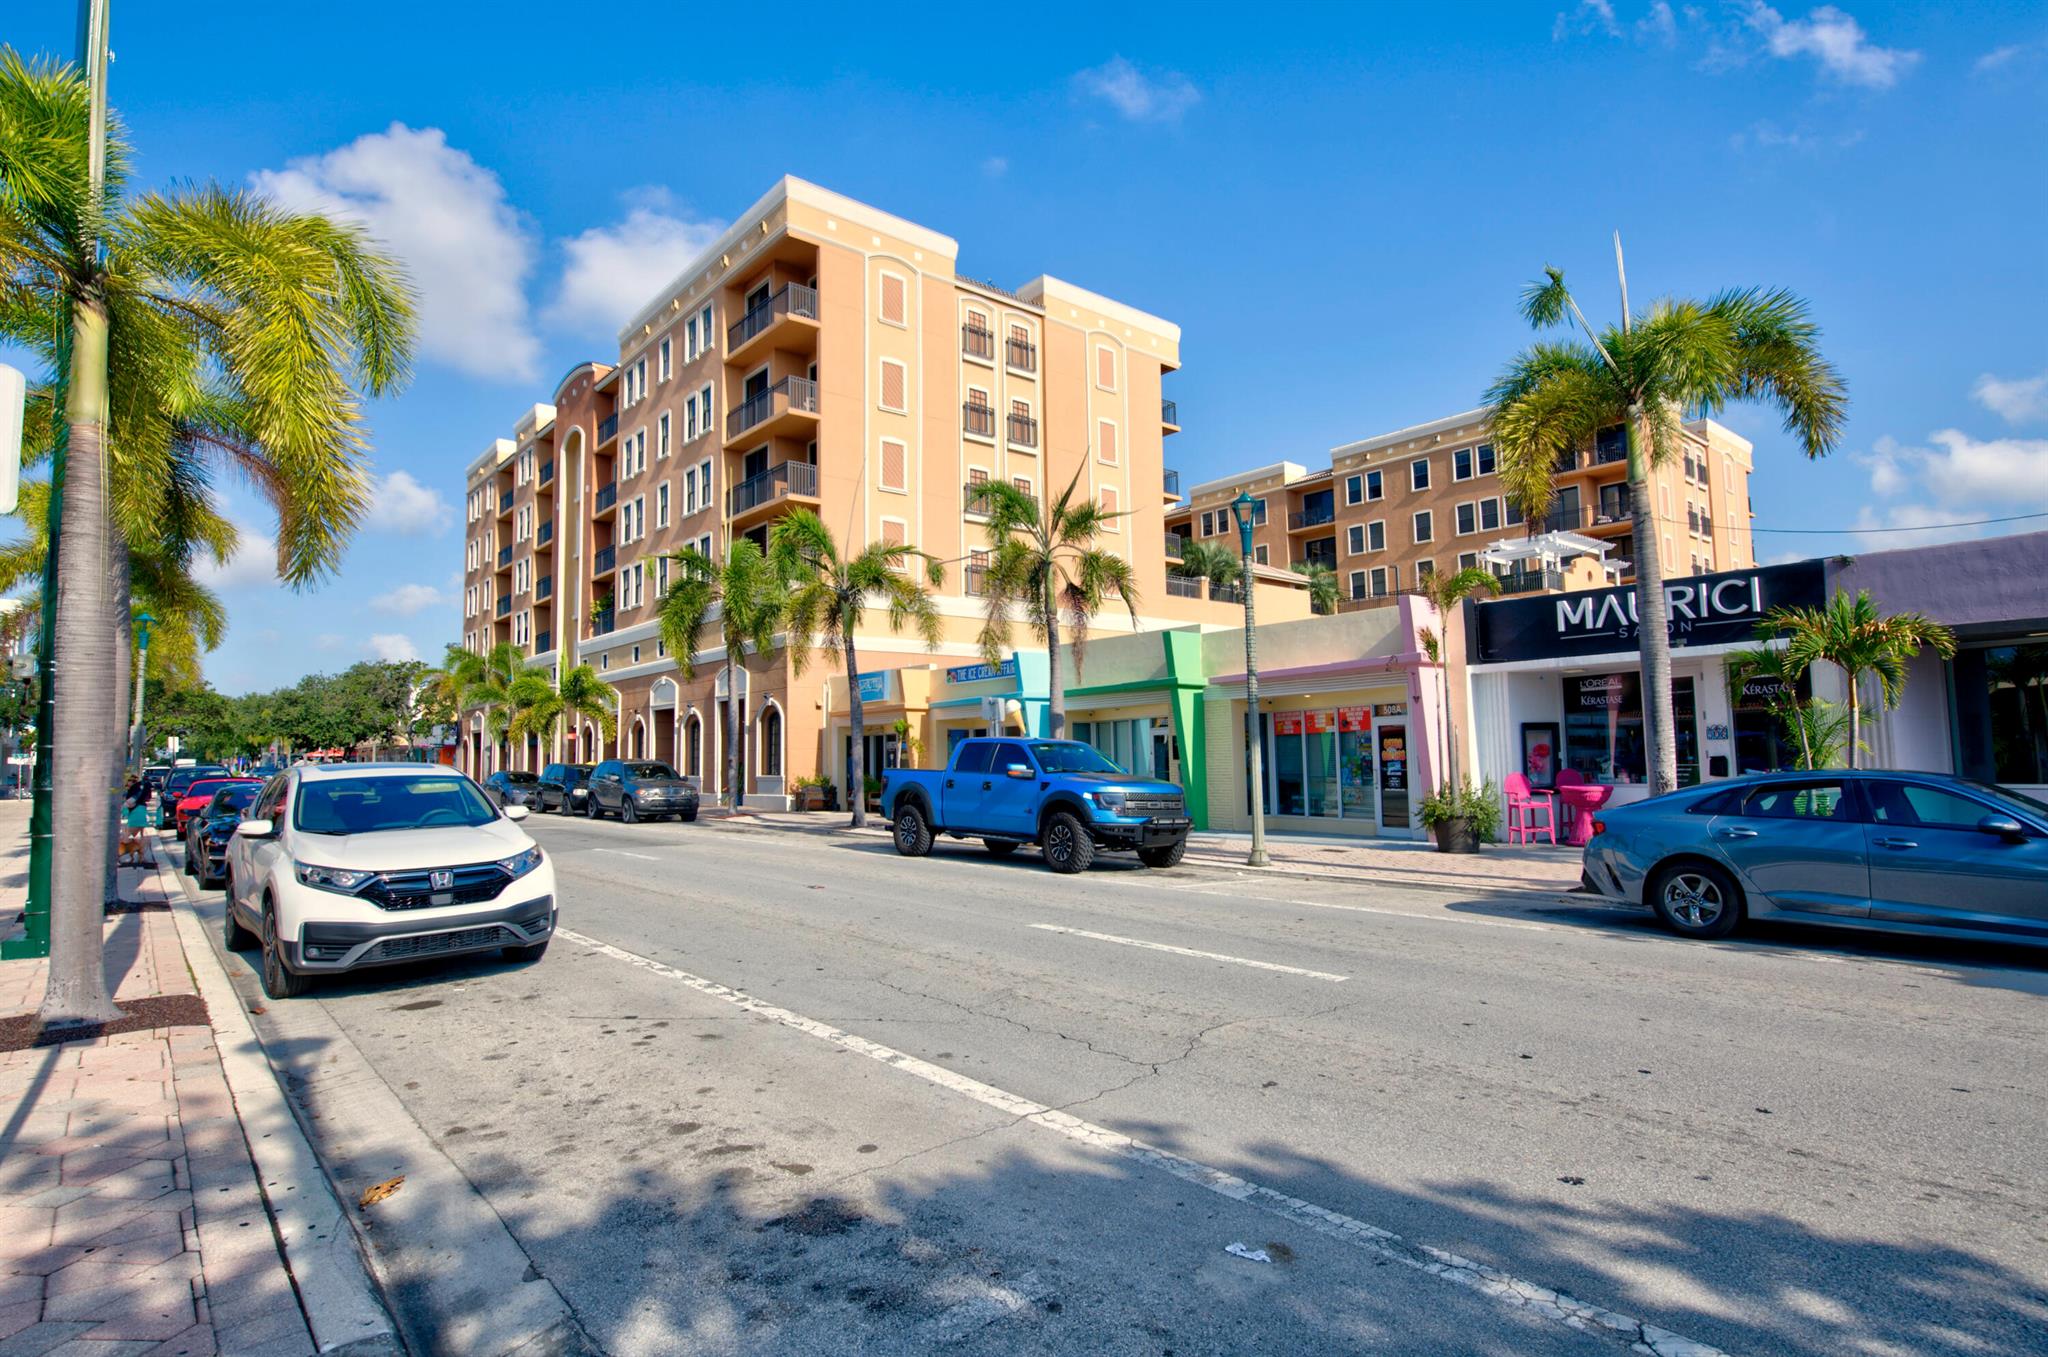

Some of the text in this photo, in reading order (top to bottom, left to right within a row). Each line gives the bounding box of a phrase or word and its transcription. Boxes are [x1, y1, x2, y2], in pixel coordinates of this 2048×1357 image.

[1618, 620, 1692, 638] SAON
[957, 668, 967, 682] THE
[967, 667, 977, 680] ICE
